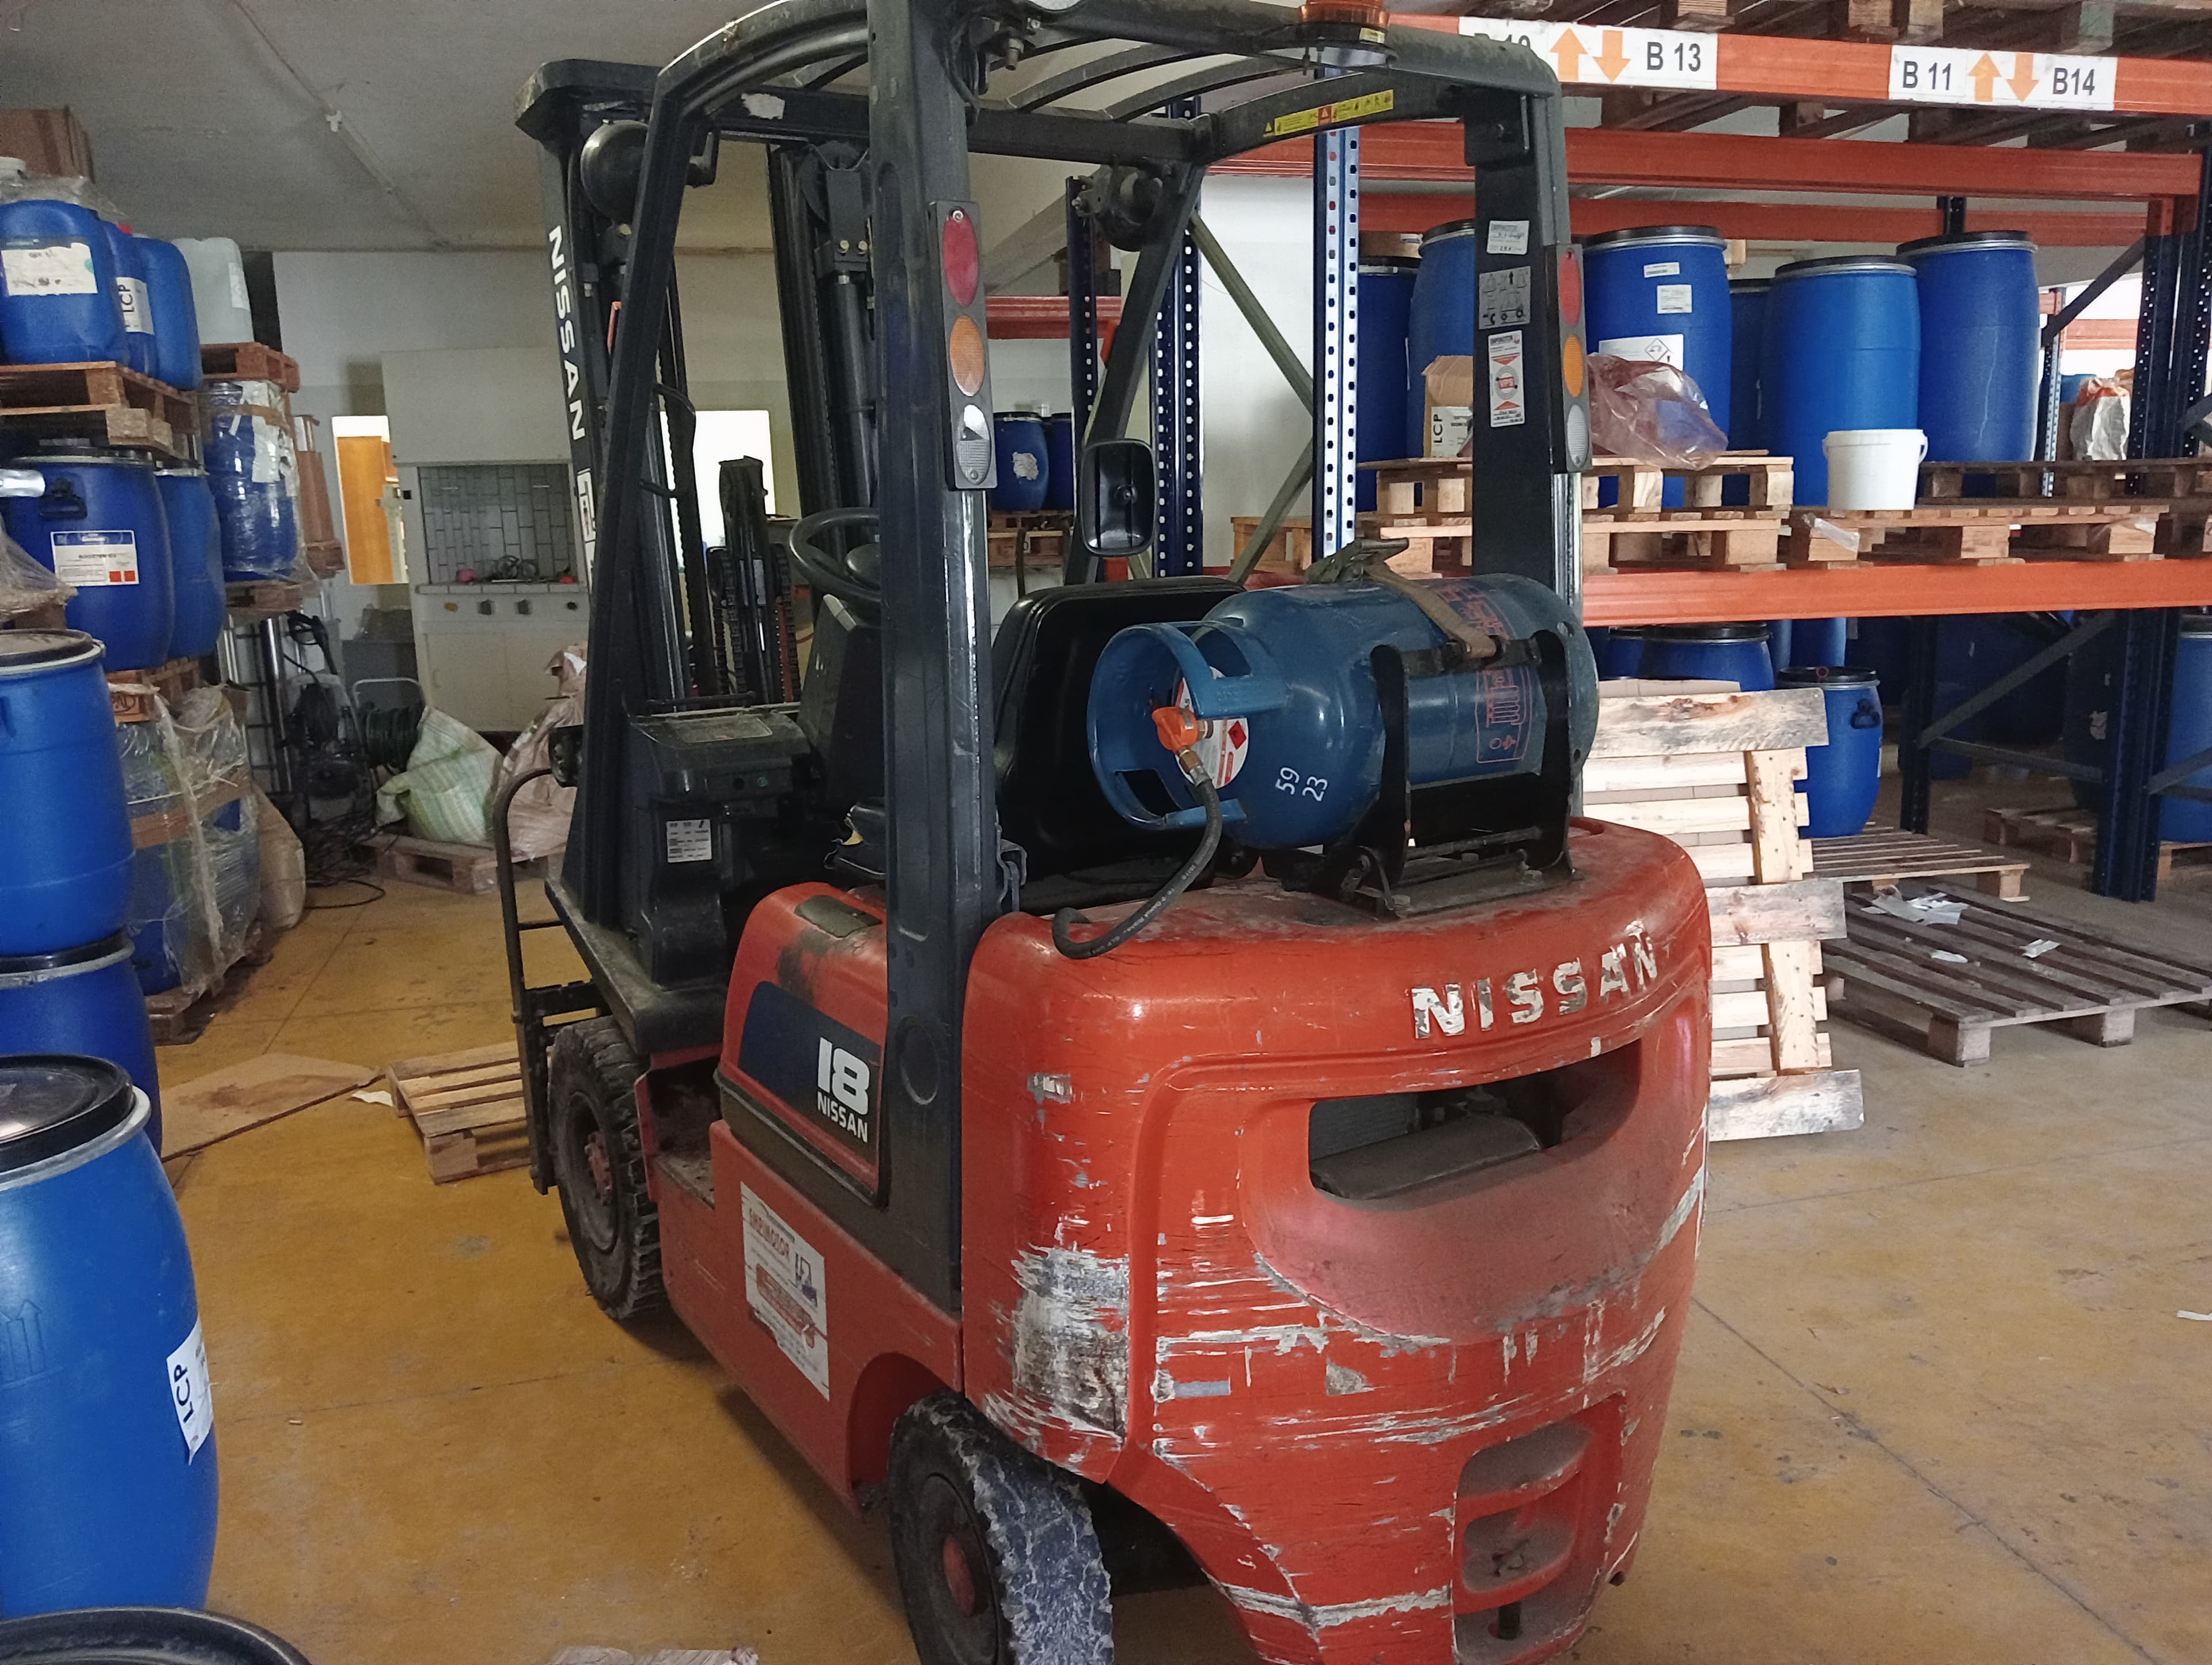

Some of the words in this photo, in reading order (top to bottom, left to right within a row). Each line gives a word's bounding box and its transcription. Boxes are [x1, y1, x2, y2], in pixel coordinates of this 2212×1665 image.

[1647, 42, 1664, 70] B
[1675, 43, 1701, 72] 13
[1903, 61, 1918, 89] B
[1928, 63, 1952, 90] 11
[2053, 68, 2095, 95] B14
[119, 285, 134, 313] LCP
[549, 225, 585, 441] NISSAN
[1433, 414, 1442, 443] LCP
[1275, 767, 1300, 795] 59
[1302, 776, 1328, 802] 23
[1411, 921, 1658, 1039] NISSAN
[817, 1037, 870, 1115] 18
[817, 1091, 868, 1143] NISSAN
[174, 1364, 194, 1423] LCP
